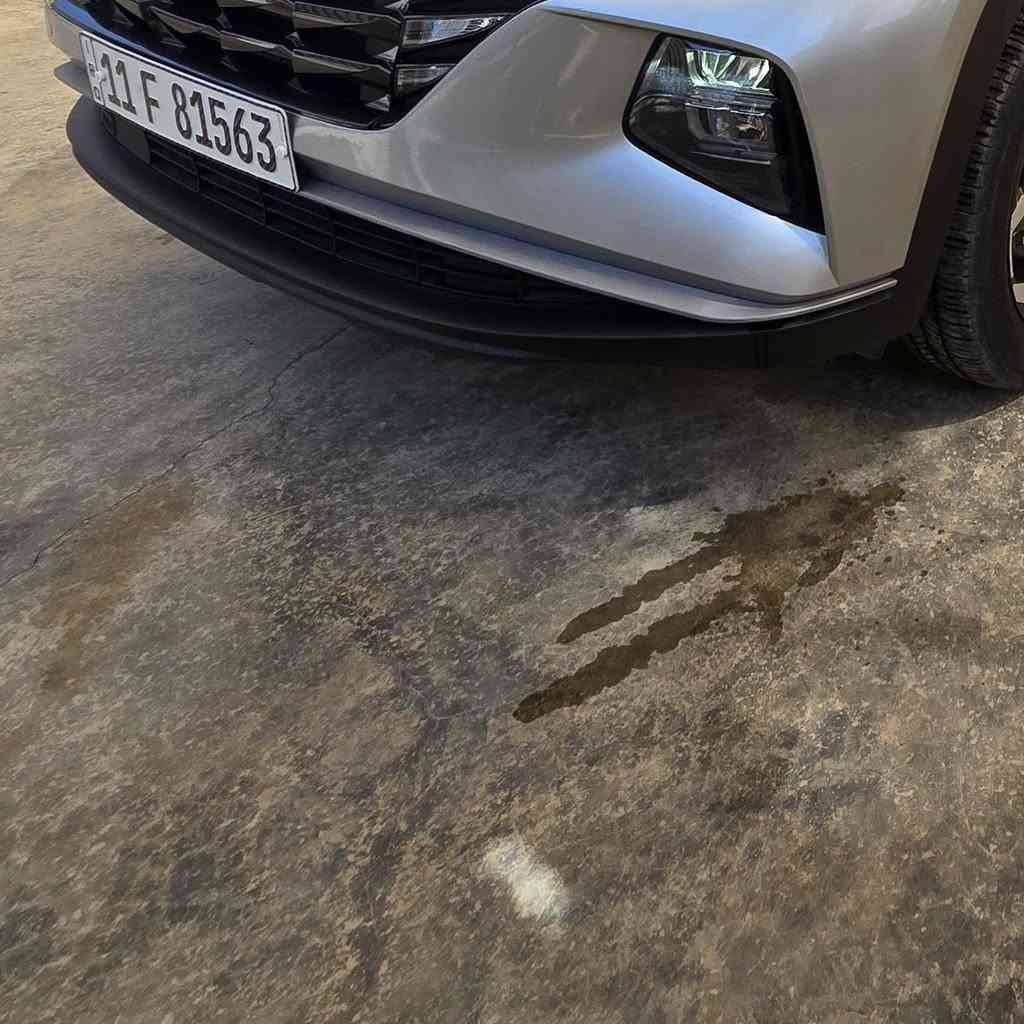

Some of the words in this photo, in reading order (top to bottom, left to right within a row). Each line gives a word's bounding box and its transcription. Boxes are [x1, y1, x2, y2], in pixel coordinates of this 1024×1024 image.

[100, 53, 137, 115] 11
[140, 70, 160, 124] F
[171, 82, 277, 173] 81563
